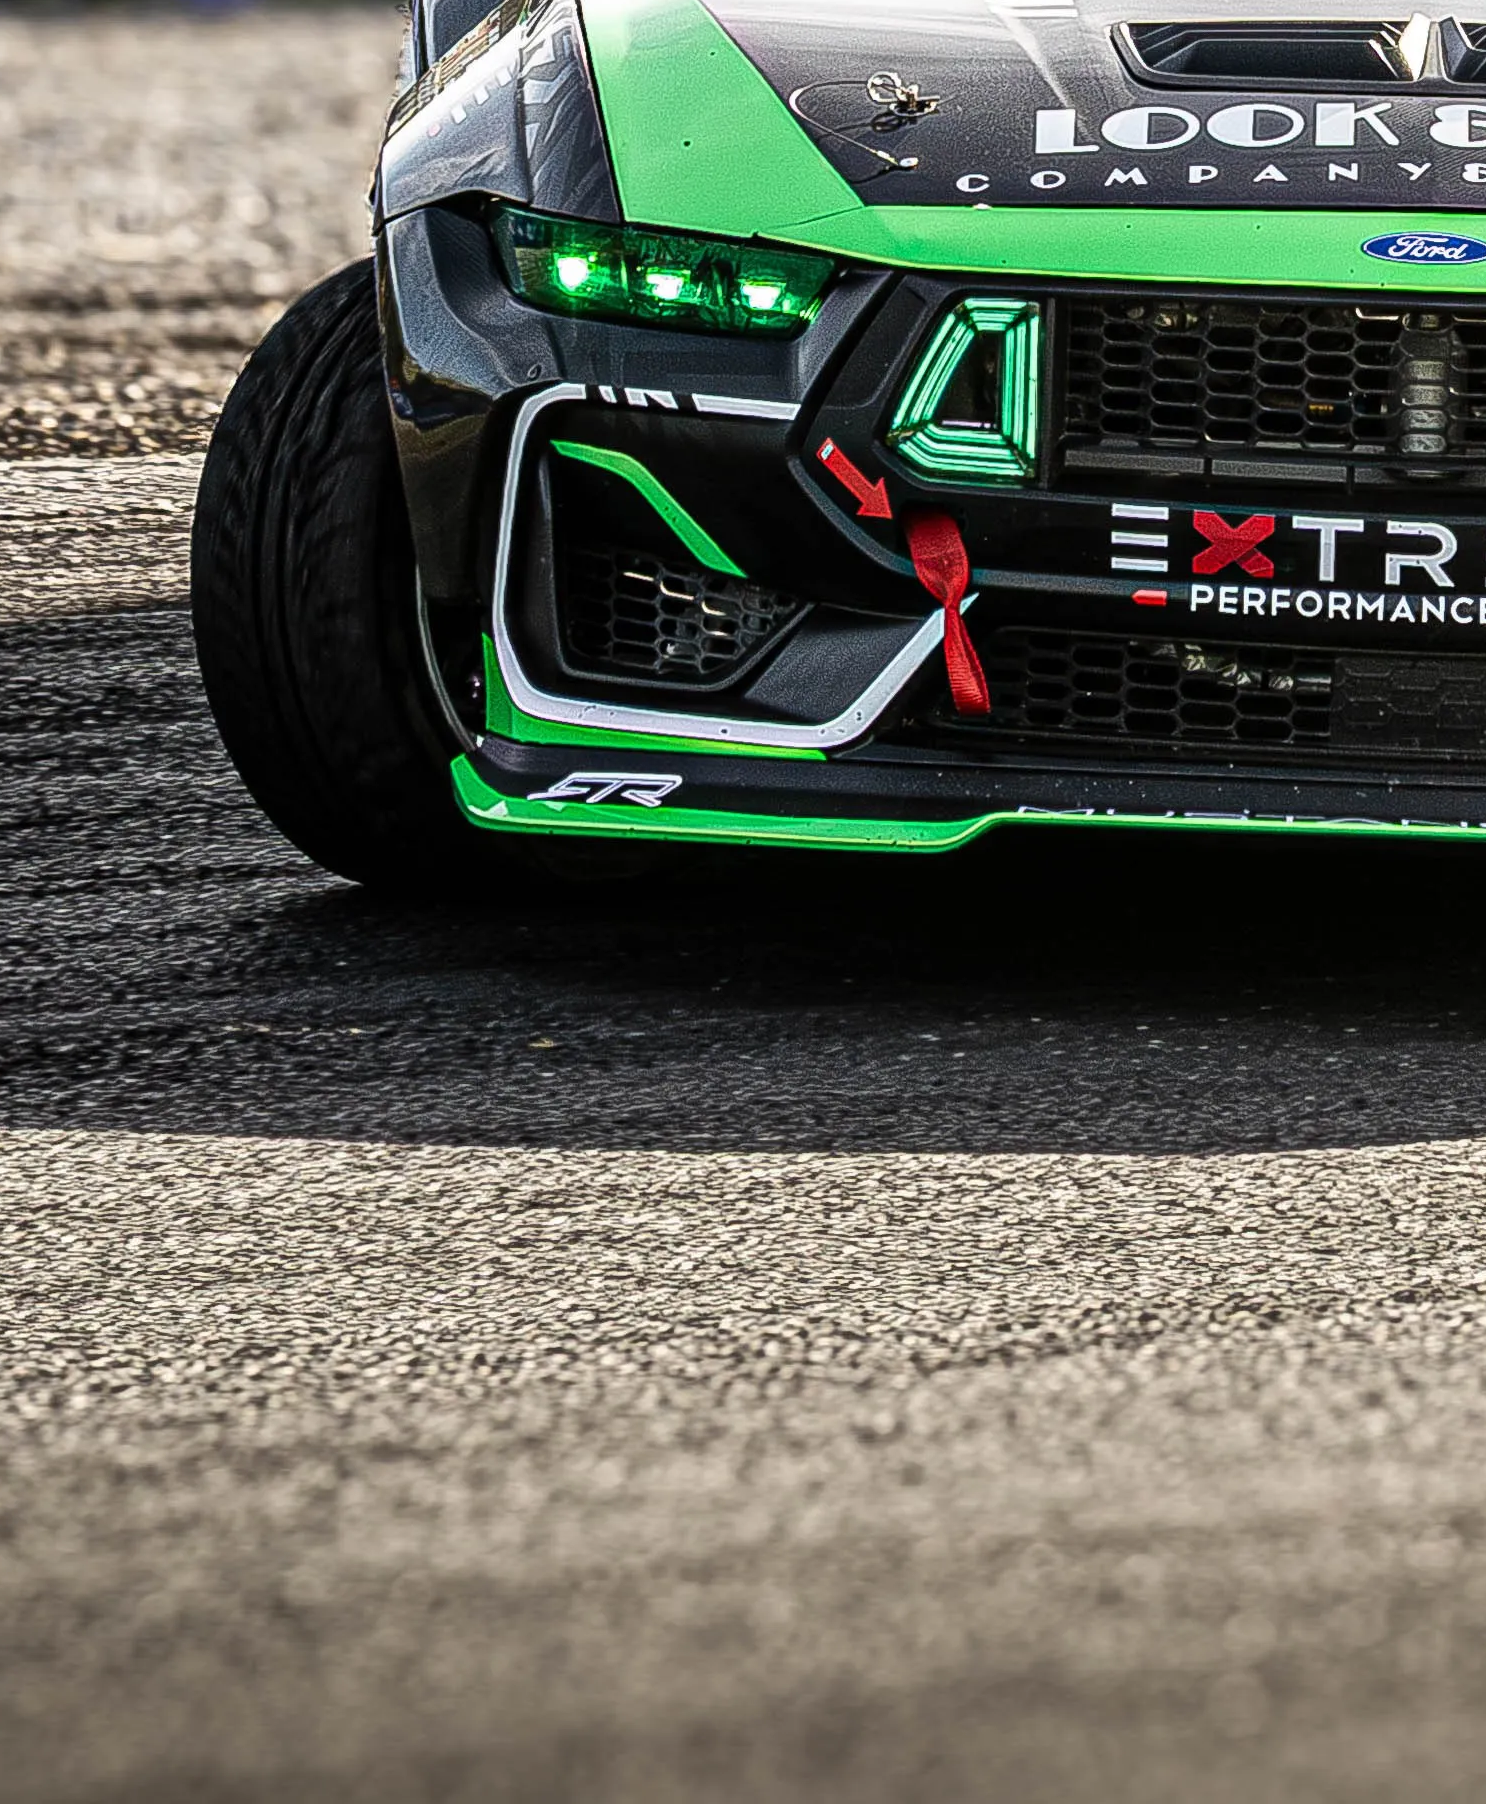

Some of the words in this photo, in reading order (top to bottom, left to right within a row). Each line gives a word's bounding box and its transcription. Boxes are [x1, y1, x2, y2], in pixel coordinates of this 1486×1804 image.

[1035, 102, 1400, 155] LOOK
[955, 161, 1432, 194] COMPANY
[1387, 236, 1467, 263] Ford
